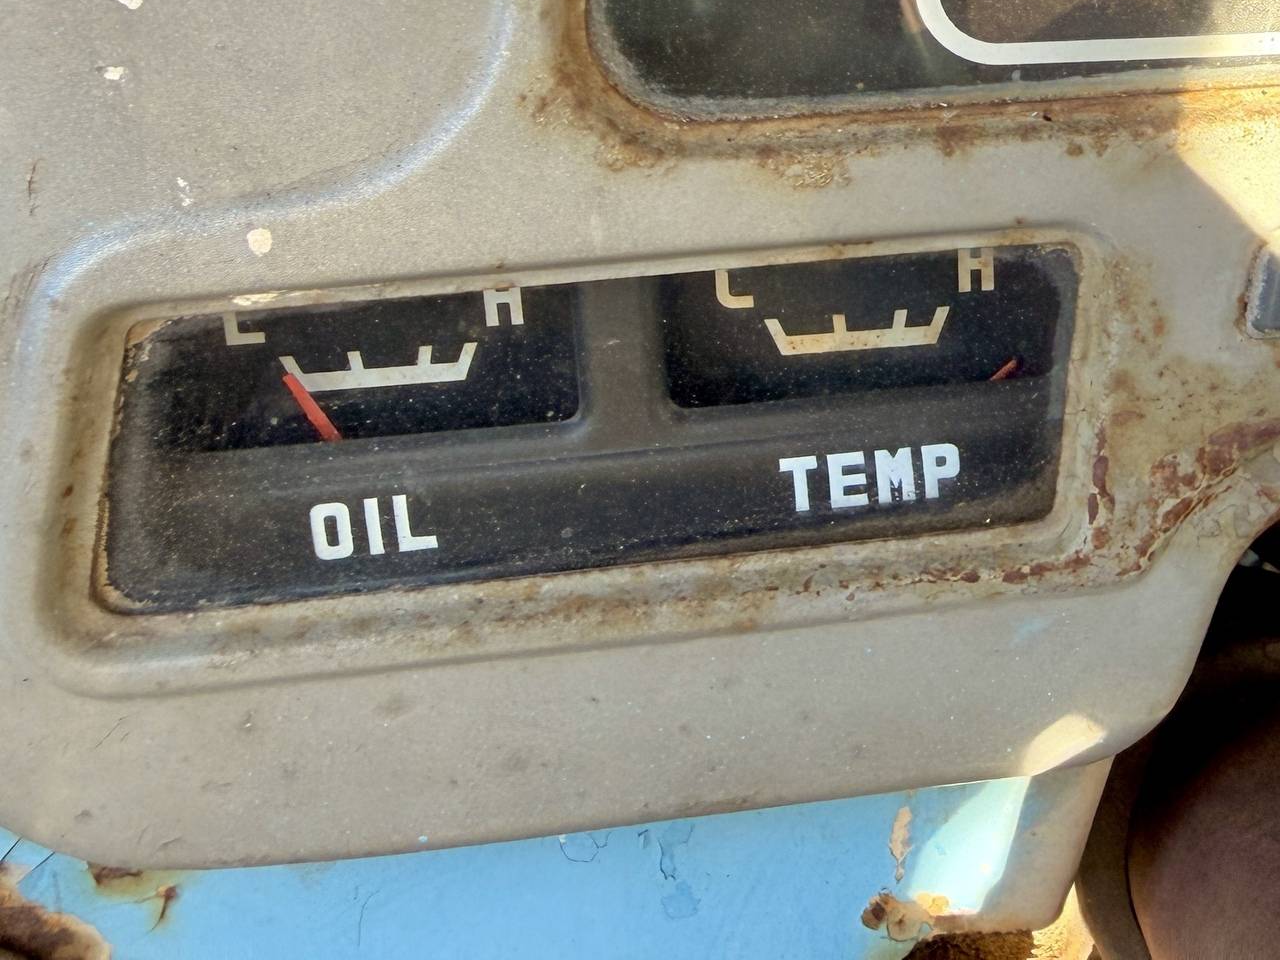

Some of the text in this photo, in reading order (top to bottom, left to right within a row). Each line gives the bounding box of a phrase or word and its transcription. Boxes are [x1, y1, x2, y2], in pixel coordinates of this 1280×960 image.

[957, 247, 996, 293] H
[778, 442, 961, 513] TEMP
[309, 494, 439, 561] OIL
